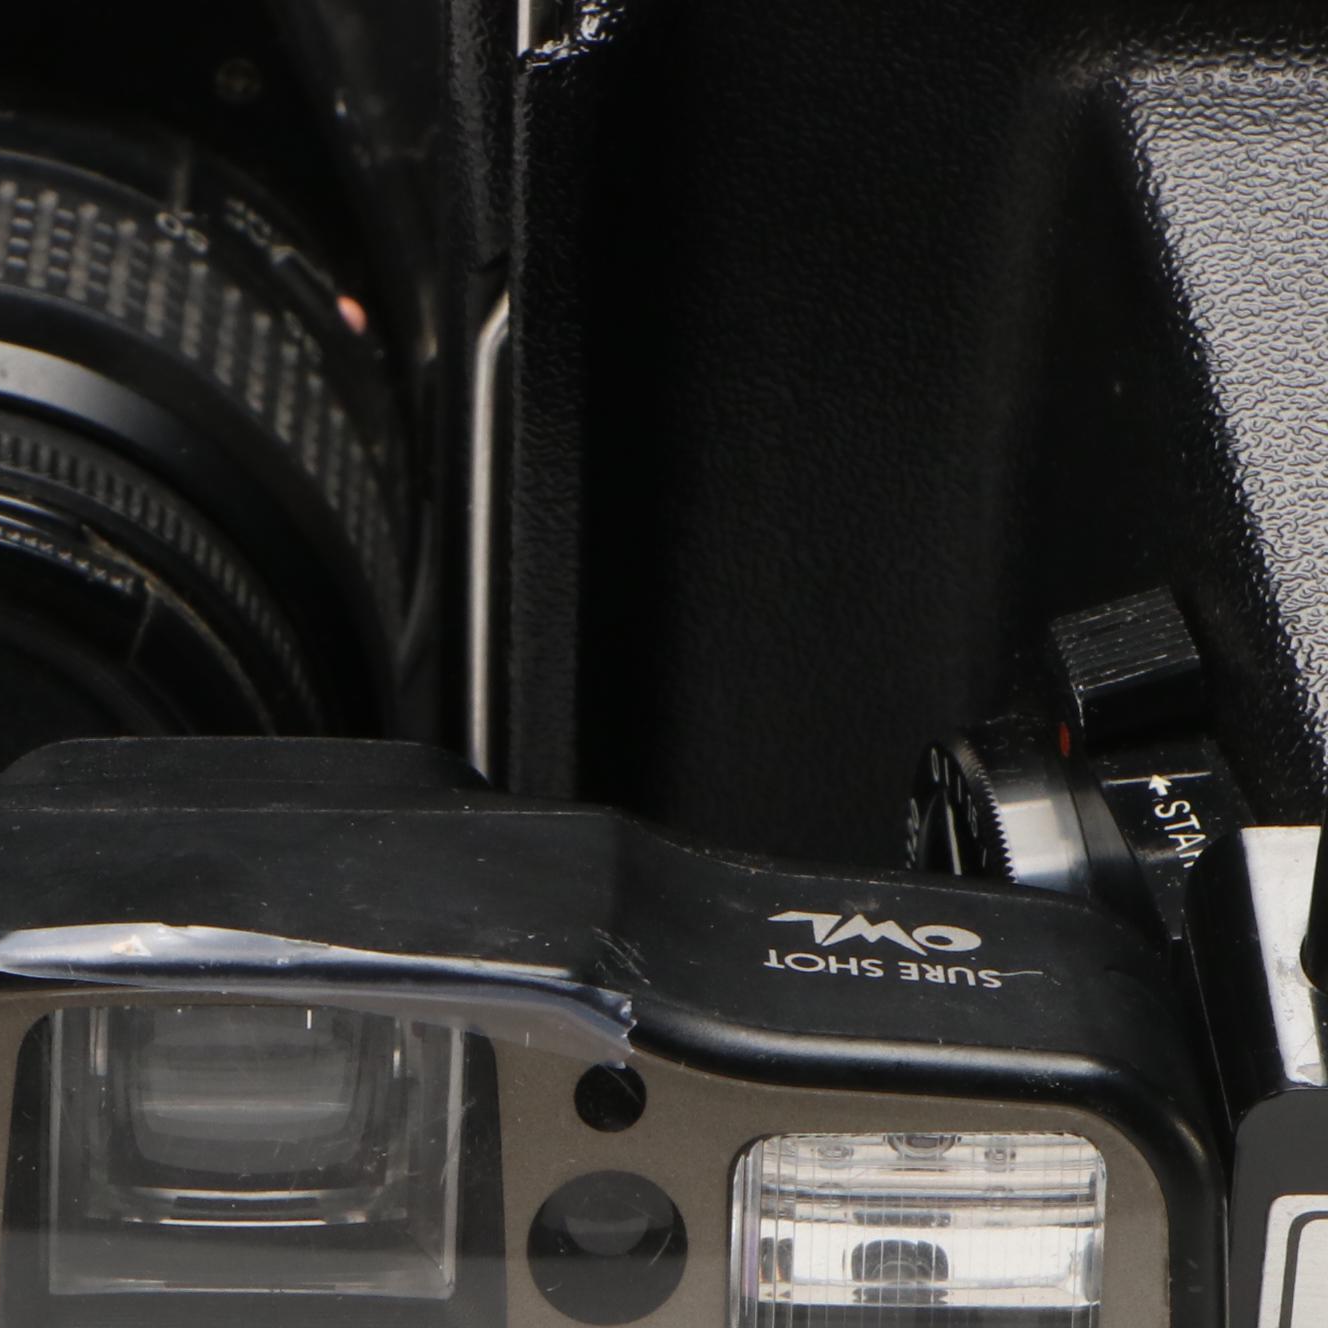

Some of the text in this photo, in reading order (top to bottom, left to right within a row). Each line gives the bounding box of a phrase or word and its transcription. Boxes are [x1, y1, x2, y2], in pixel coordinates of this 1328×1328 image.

[768, 910, 982, 957] OWL
[763, 949, 1003, 989] SURE SHOT
